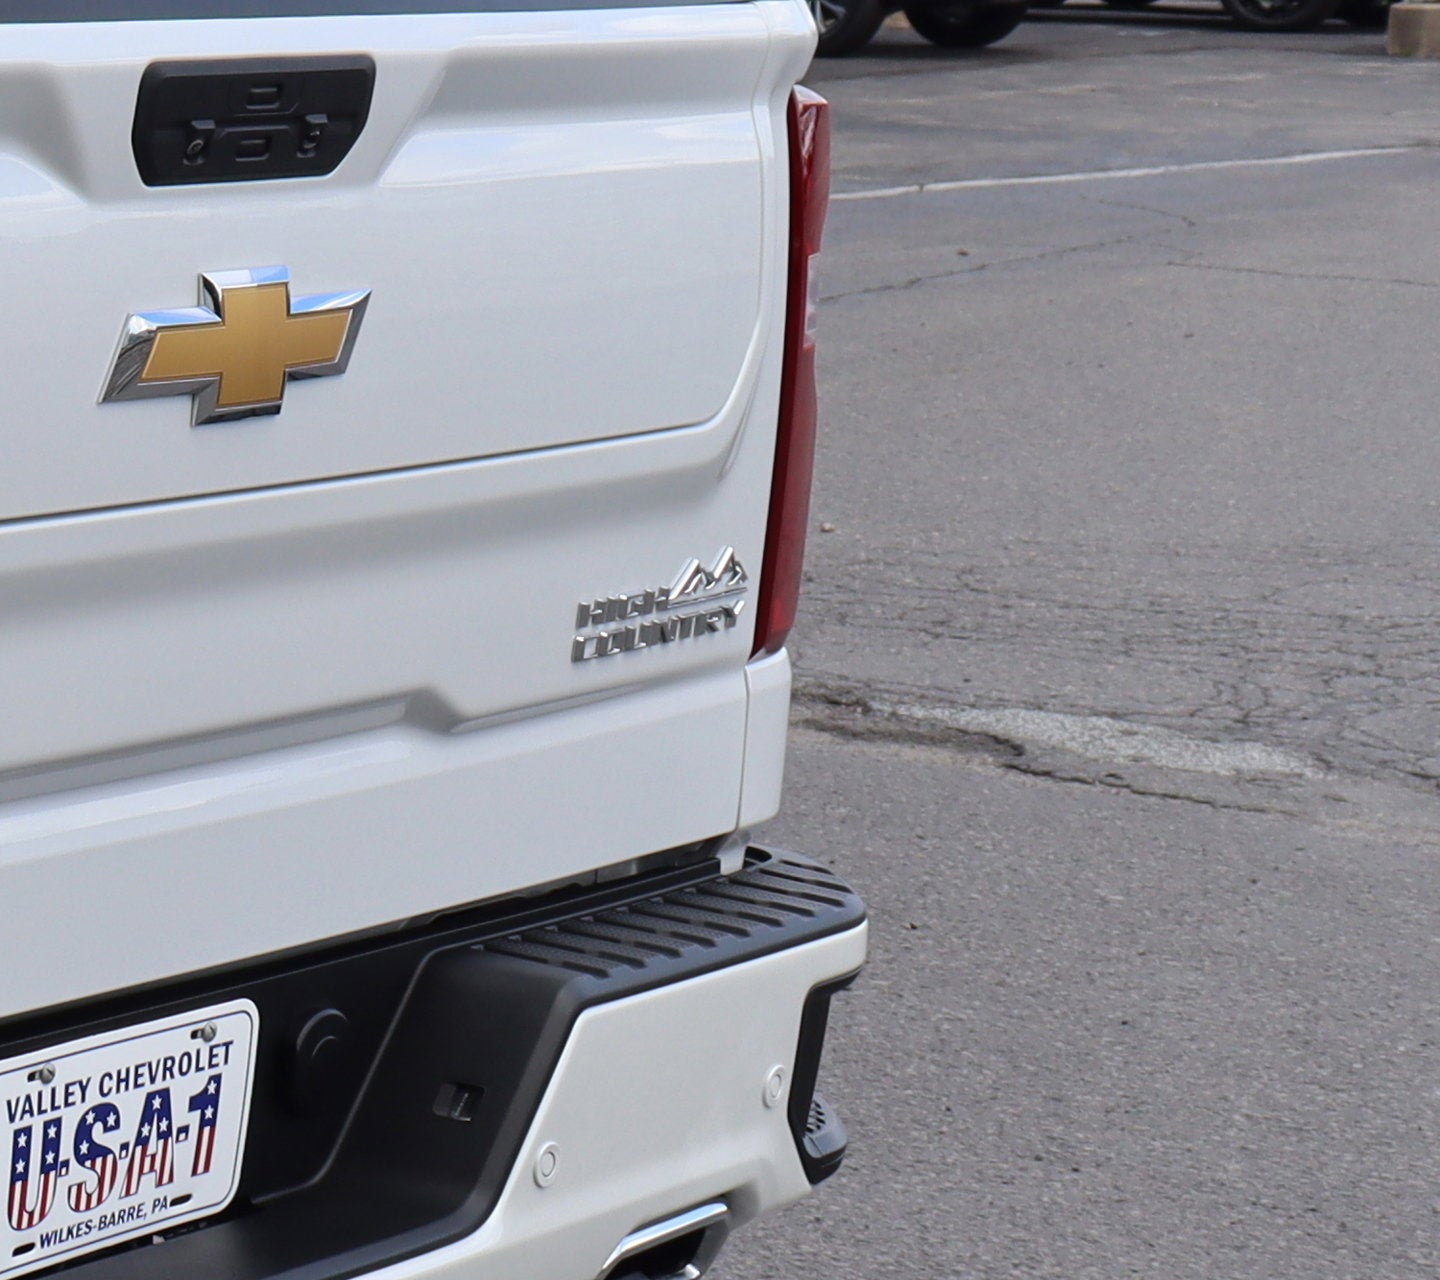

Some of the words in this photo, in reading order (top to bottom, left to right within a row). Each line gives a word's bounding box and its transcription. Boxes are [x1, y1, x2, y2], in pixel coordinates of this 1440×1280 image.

[570, 599, 746, 663] COUNTRY
[575, 584, 671, 629] HIGH
[6, 1077, 92, 1124] VALLEY
[98, 1040, 235, 1098] CHEVROLET
[39, 1203, 148, 1250] WILKES-BARRE,
[152, 1195, 170, 1214] PA
